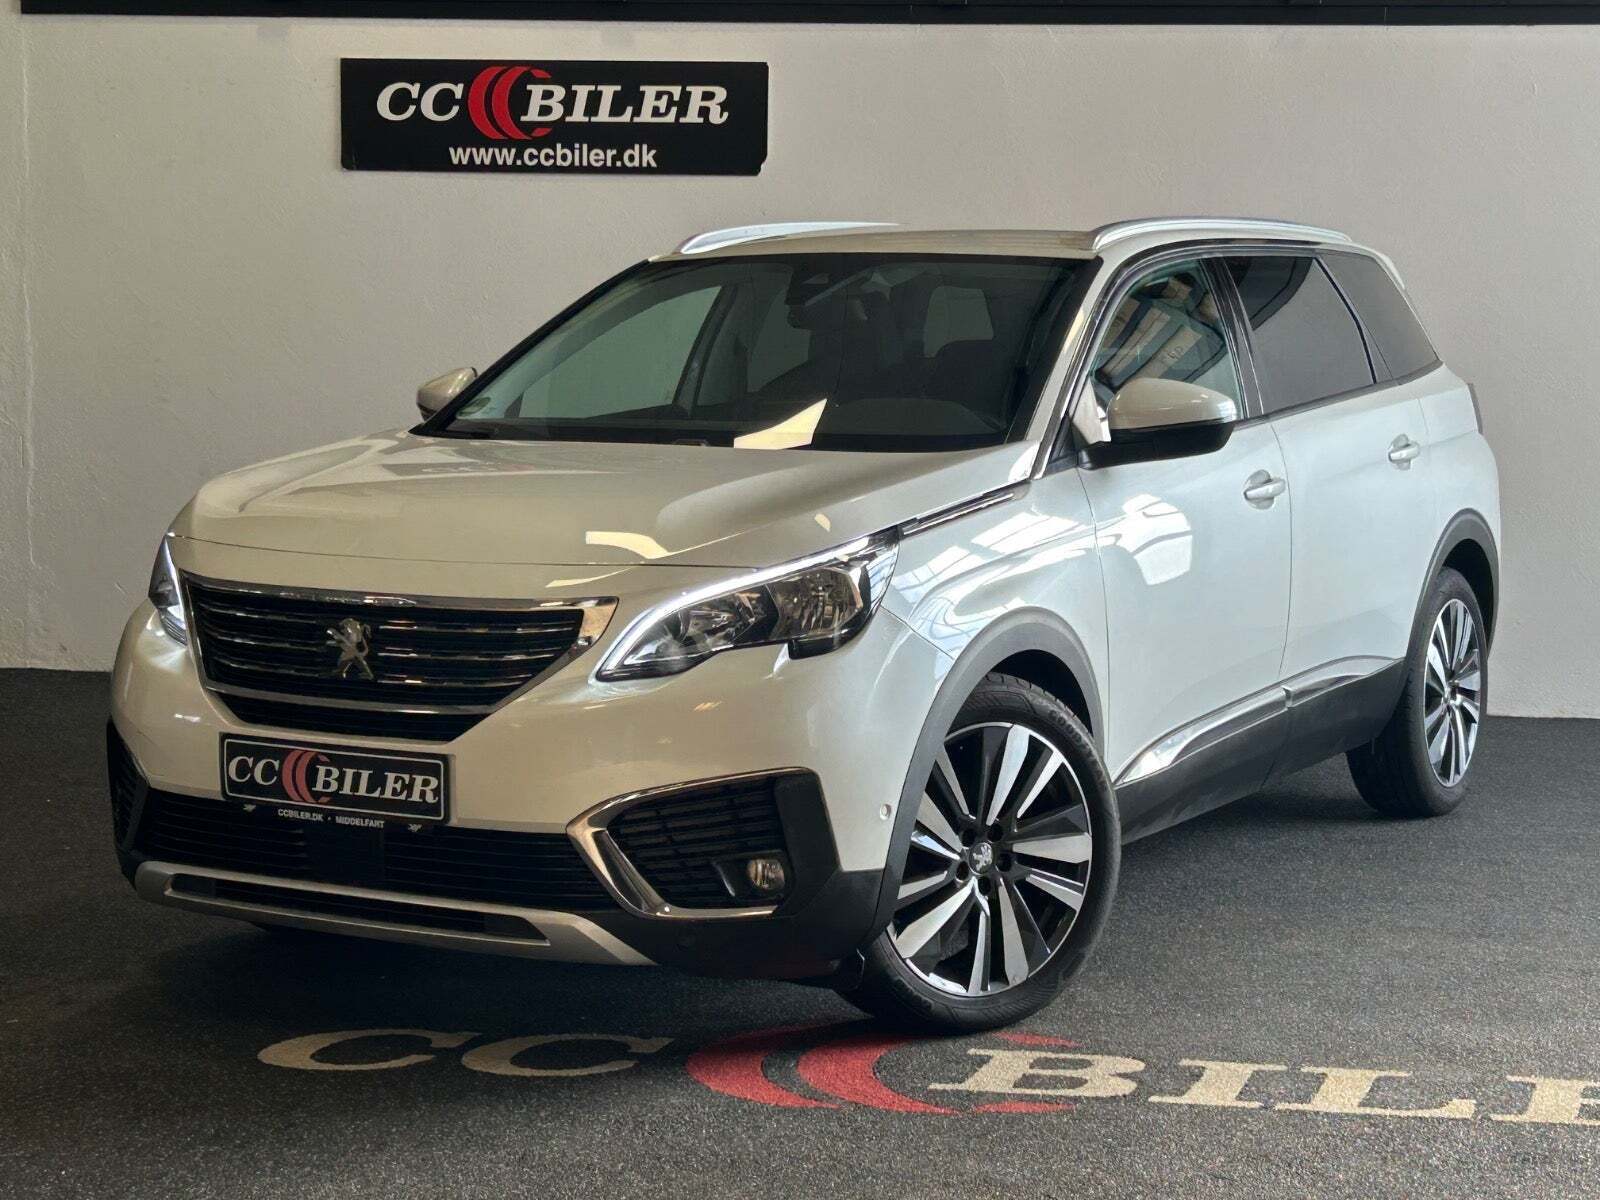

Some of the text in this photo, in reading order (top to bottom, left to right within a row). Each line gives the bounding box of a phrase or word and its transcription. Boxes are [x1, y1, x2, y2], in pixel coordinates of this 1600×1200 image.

[376, 82, 729, 125] CC BILER
[448, 143, 658, 169] www.ccbiler.dk
[227, 755, 440, 804] CC BILER
[277, 808, 324, 822] CCBILER.DK
[256, 1028, 675, 1078] CC
